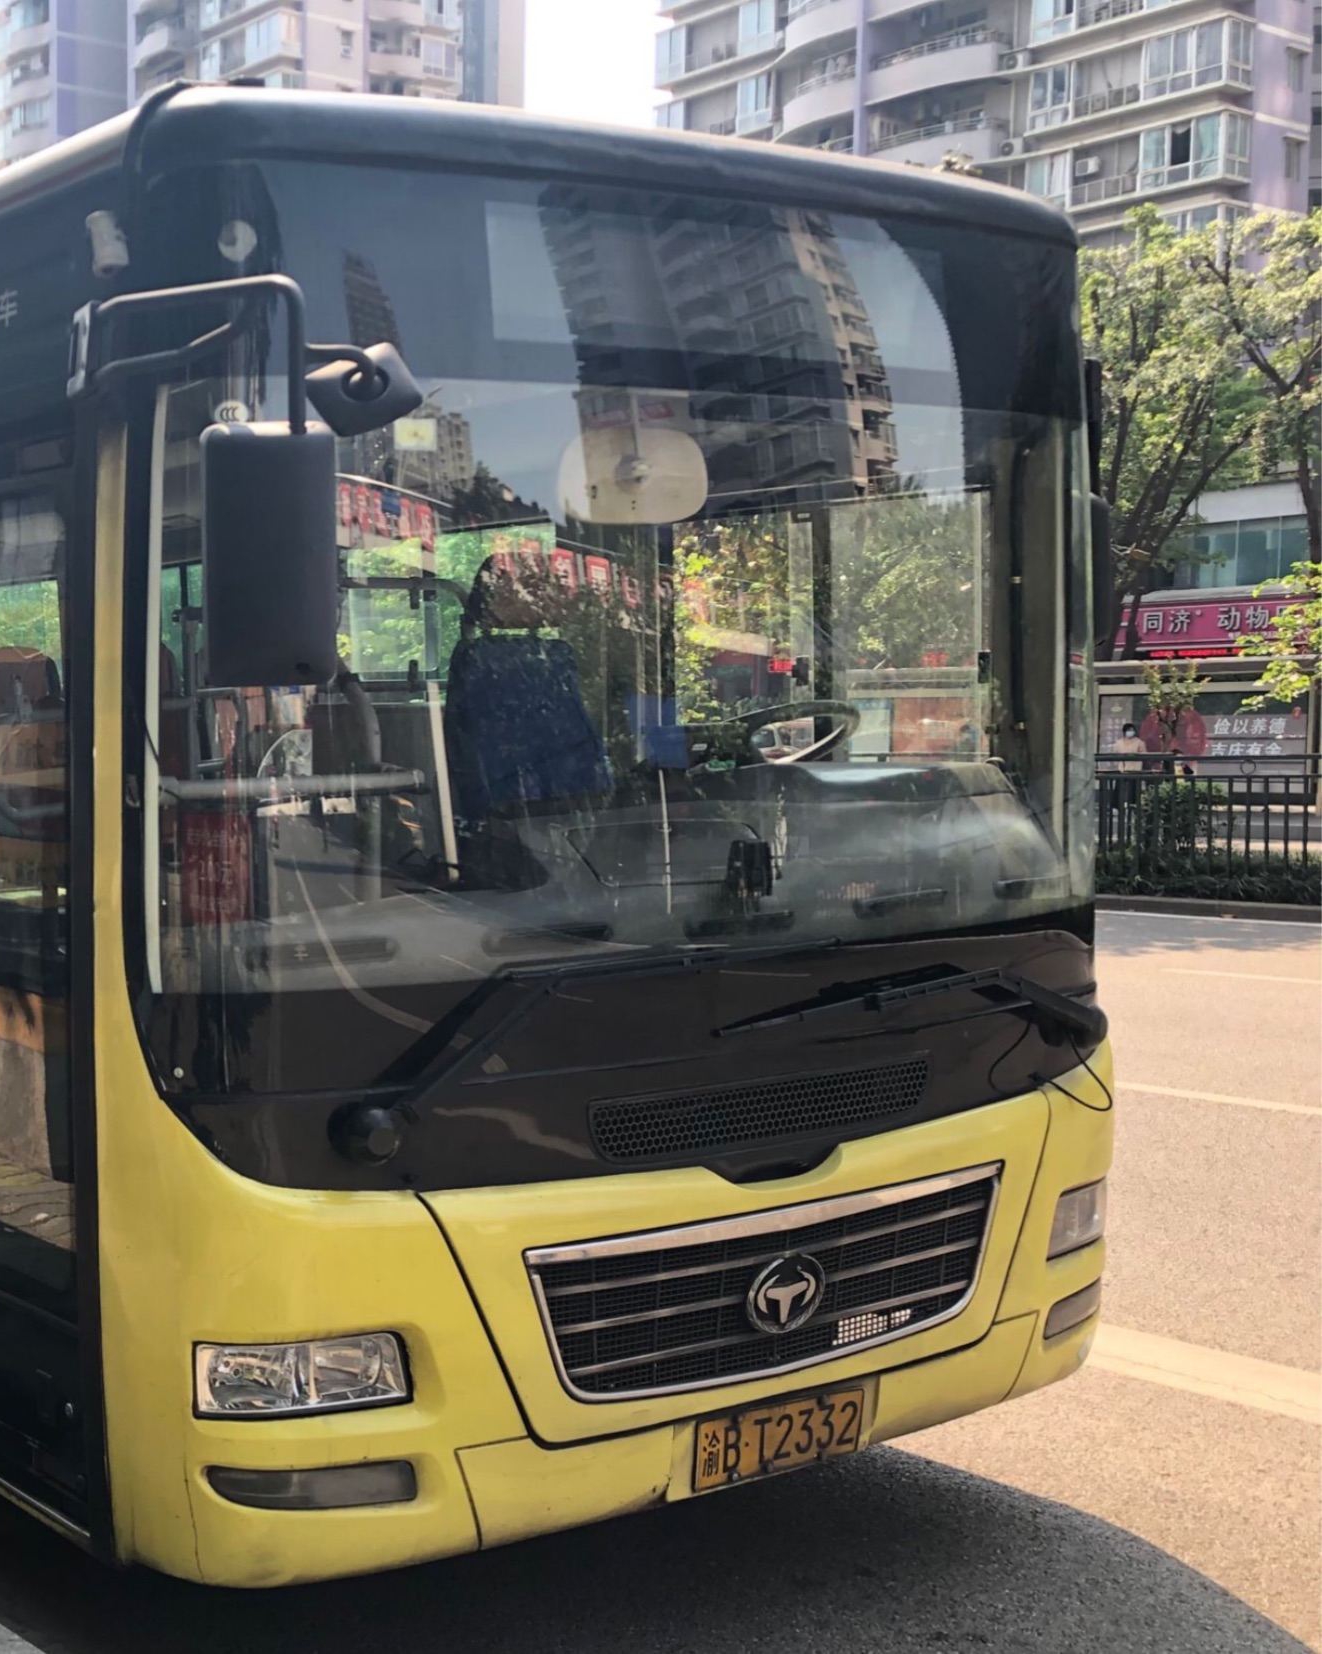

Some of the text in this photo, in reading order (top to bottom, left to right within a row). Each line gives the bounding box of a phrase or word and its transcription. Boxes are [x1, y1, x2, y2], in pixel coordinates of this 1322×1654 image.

[1143, 609, 1191, 633] 同济
[1213, 717, 1287, 736] 俭以养德
